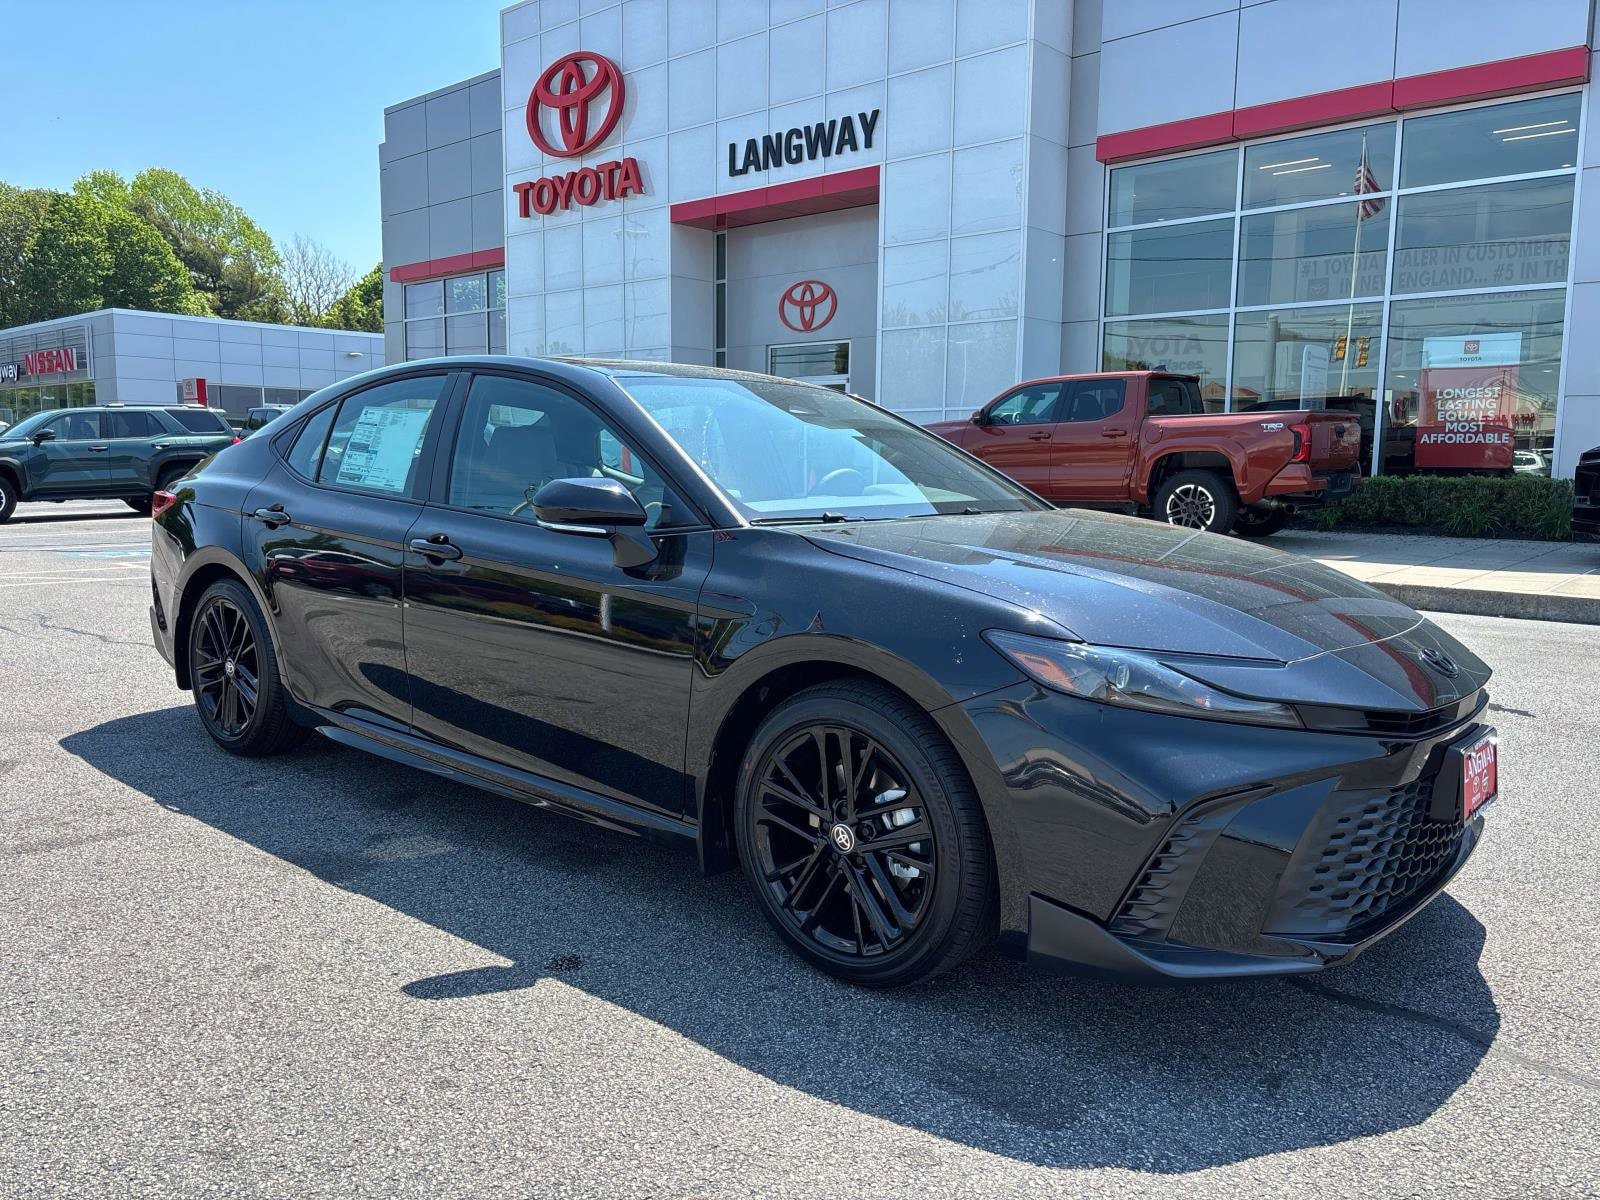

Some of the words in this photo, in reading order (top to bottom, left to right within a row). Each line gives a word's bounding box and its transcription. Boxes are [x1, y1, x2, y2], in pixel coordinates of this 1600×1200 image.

[728, 109, 880, 177] LANGWAY
[513, 157, 645, 218] TOYOTA
[1301, 260, 1317, 279] #1
[1443, 246, 1460, 265] IN
[1467, 240, 1554, 262] CUSTOMER
[1494, 263, 1514, 281] #5
[1520, 262, 1538, 280] IN
[1544, 259, 1566, 277] TH
[0, 364, 18, 382] way
[24, 347, 76, 376] NISSAN
[1436, 387, 1501, 399] LONGEST
[1437, 399, 1497, 411] LASTING
[1437, 410, 1496, 422] EQUALS
[1261, 422, 1284, 430] TRD
[1445, 422, 1486, 433] MOST
[1420, 432, 1510, 444] AFFORDABLE
[1464, 742, 1495, 783] LANGWAY
